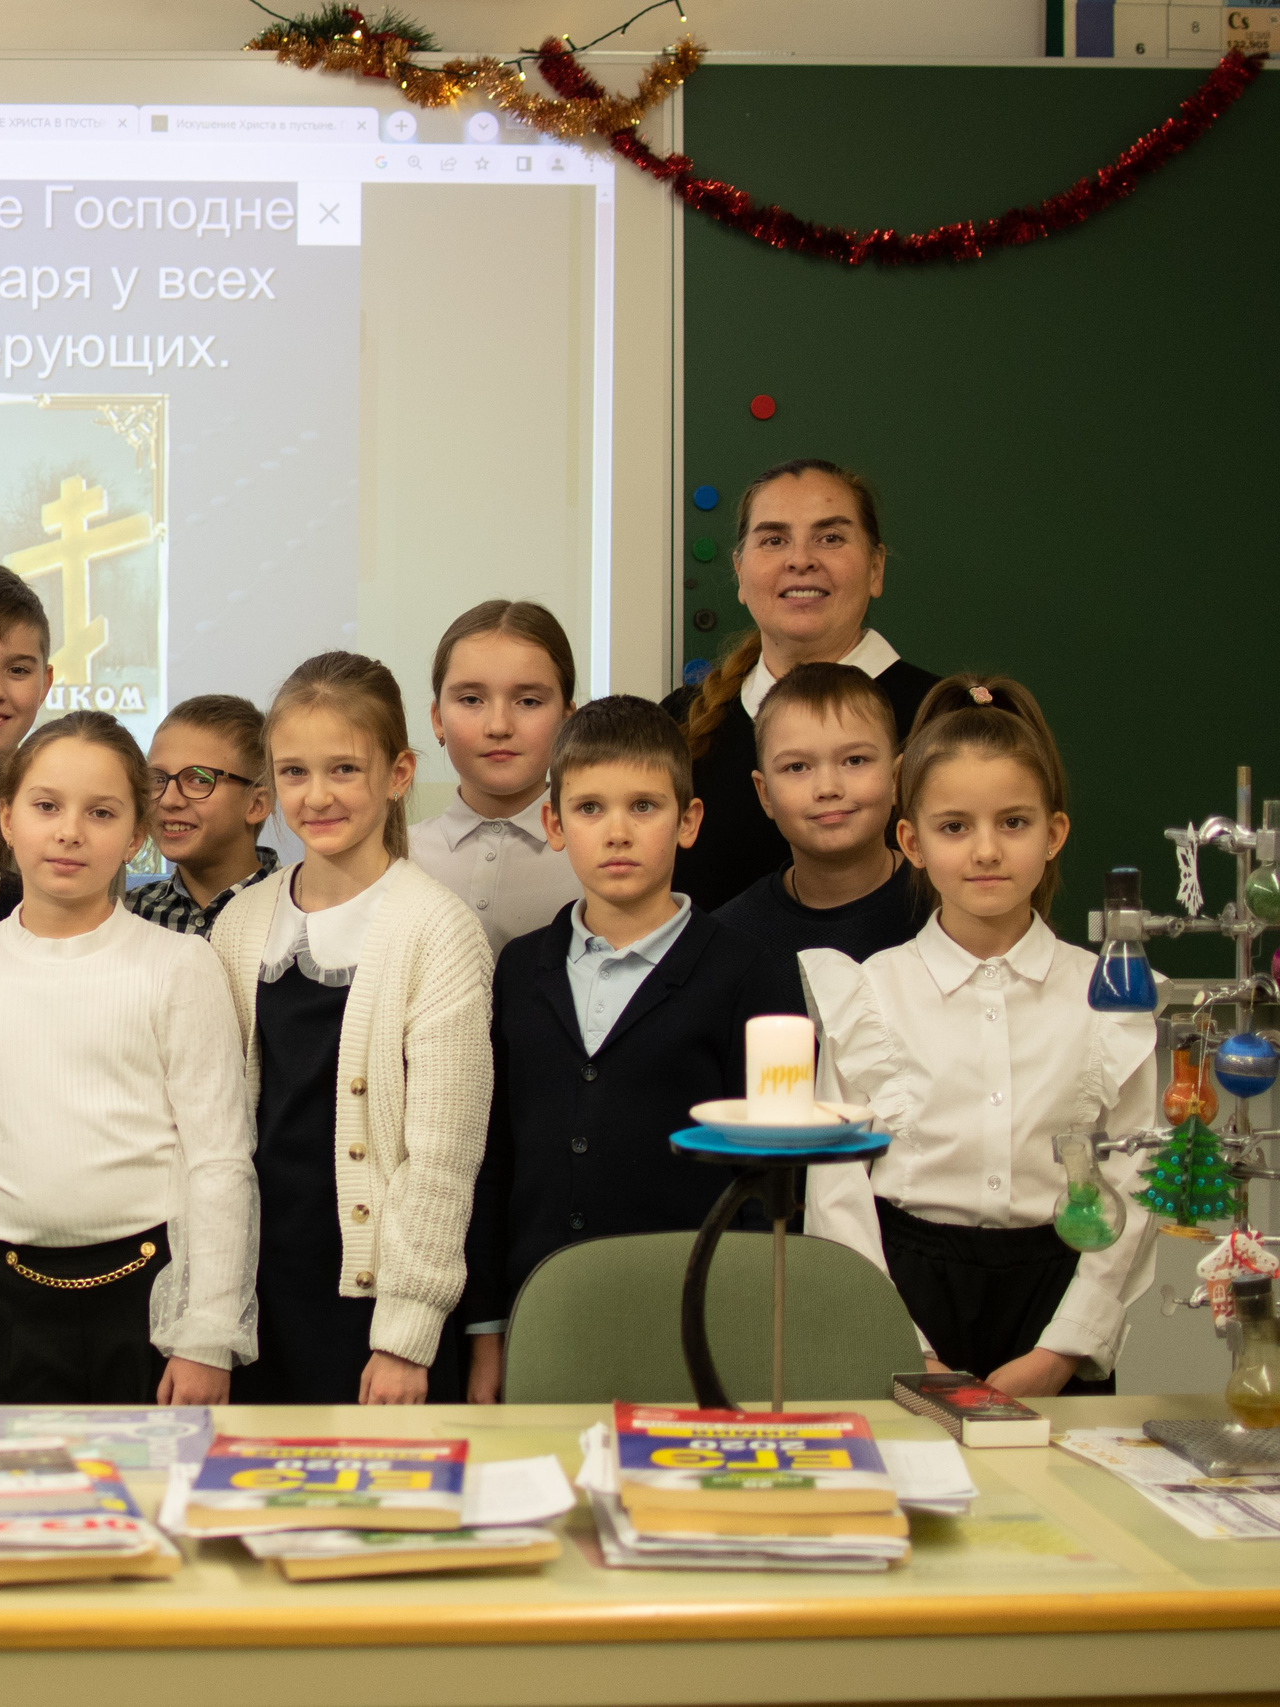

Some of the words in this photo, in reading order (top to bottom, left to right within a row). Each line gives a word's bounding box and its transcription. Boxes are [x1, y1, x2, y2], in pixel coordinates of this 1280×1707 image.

[1191, 21, 1200, 33] 8
[1227, 11, 1250, 30] Cs
[1135, 43, 1145, 55] 6
[9, 117, 51, 129] ХРИСТА
[54, 117, 62, 129] В
[176, 118, 236, 131] Искушение
[239, 118, 276, 131] Христа
[280, 121, 286, 130] в
[289, 121, 337, 132] пустыне.
[45, 185, 295, 236] Господне
[111, 264, 139, 312] у
[158, 265, 277, 302] всех
[689, 1439, 806, 1452] 2020
[649, 1447, 853, 1470] ЕГЭ
[230, 1468, 433, 1491] ЕГЭ
